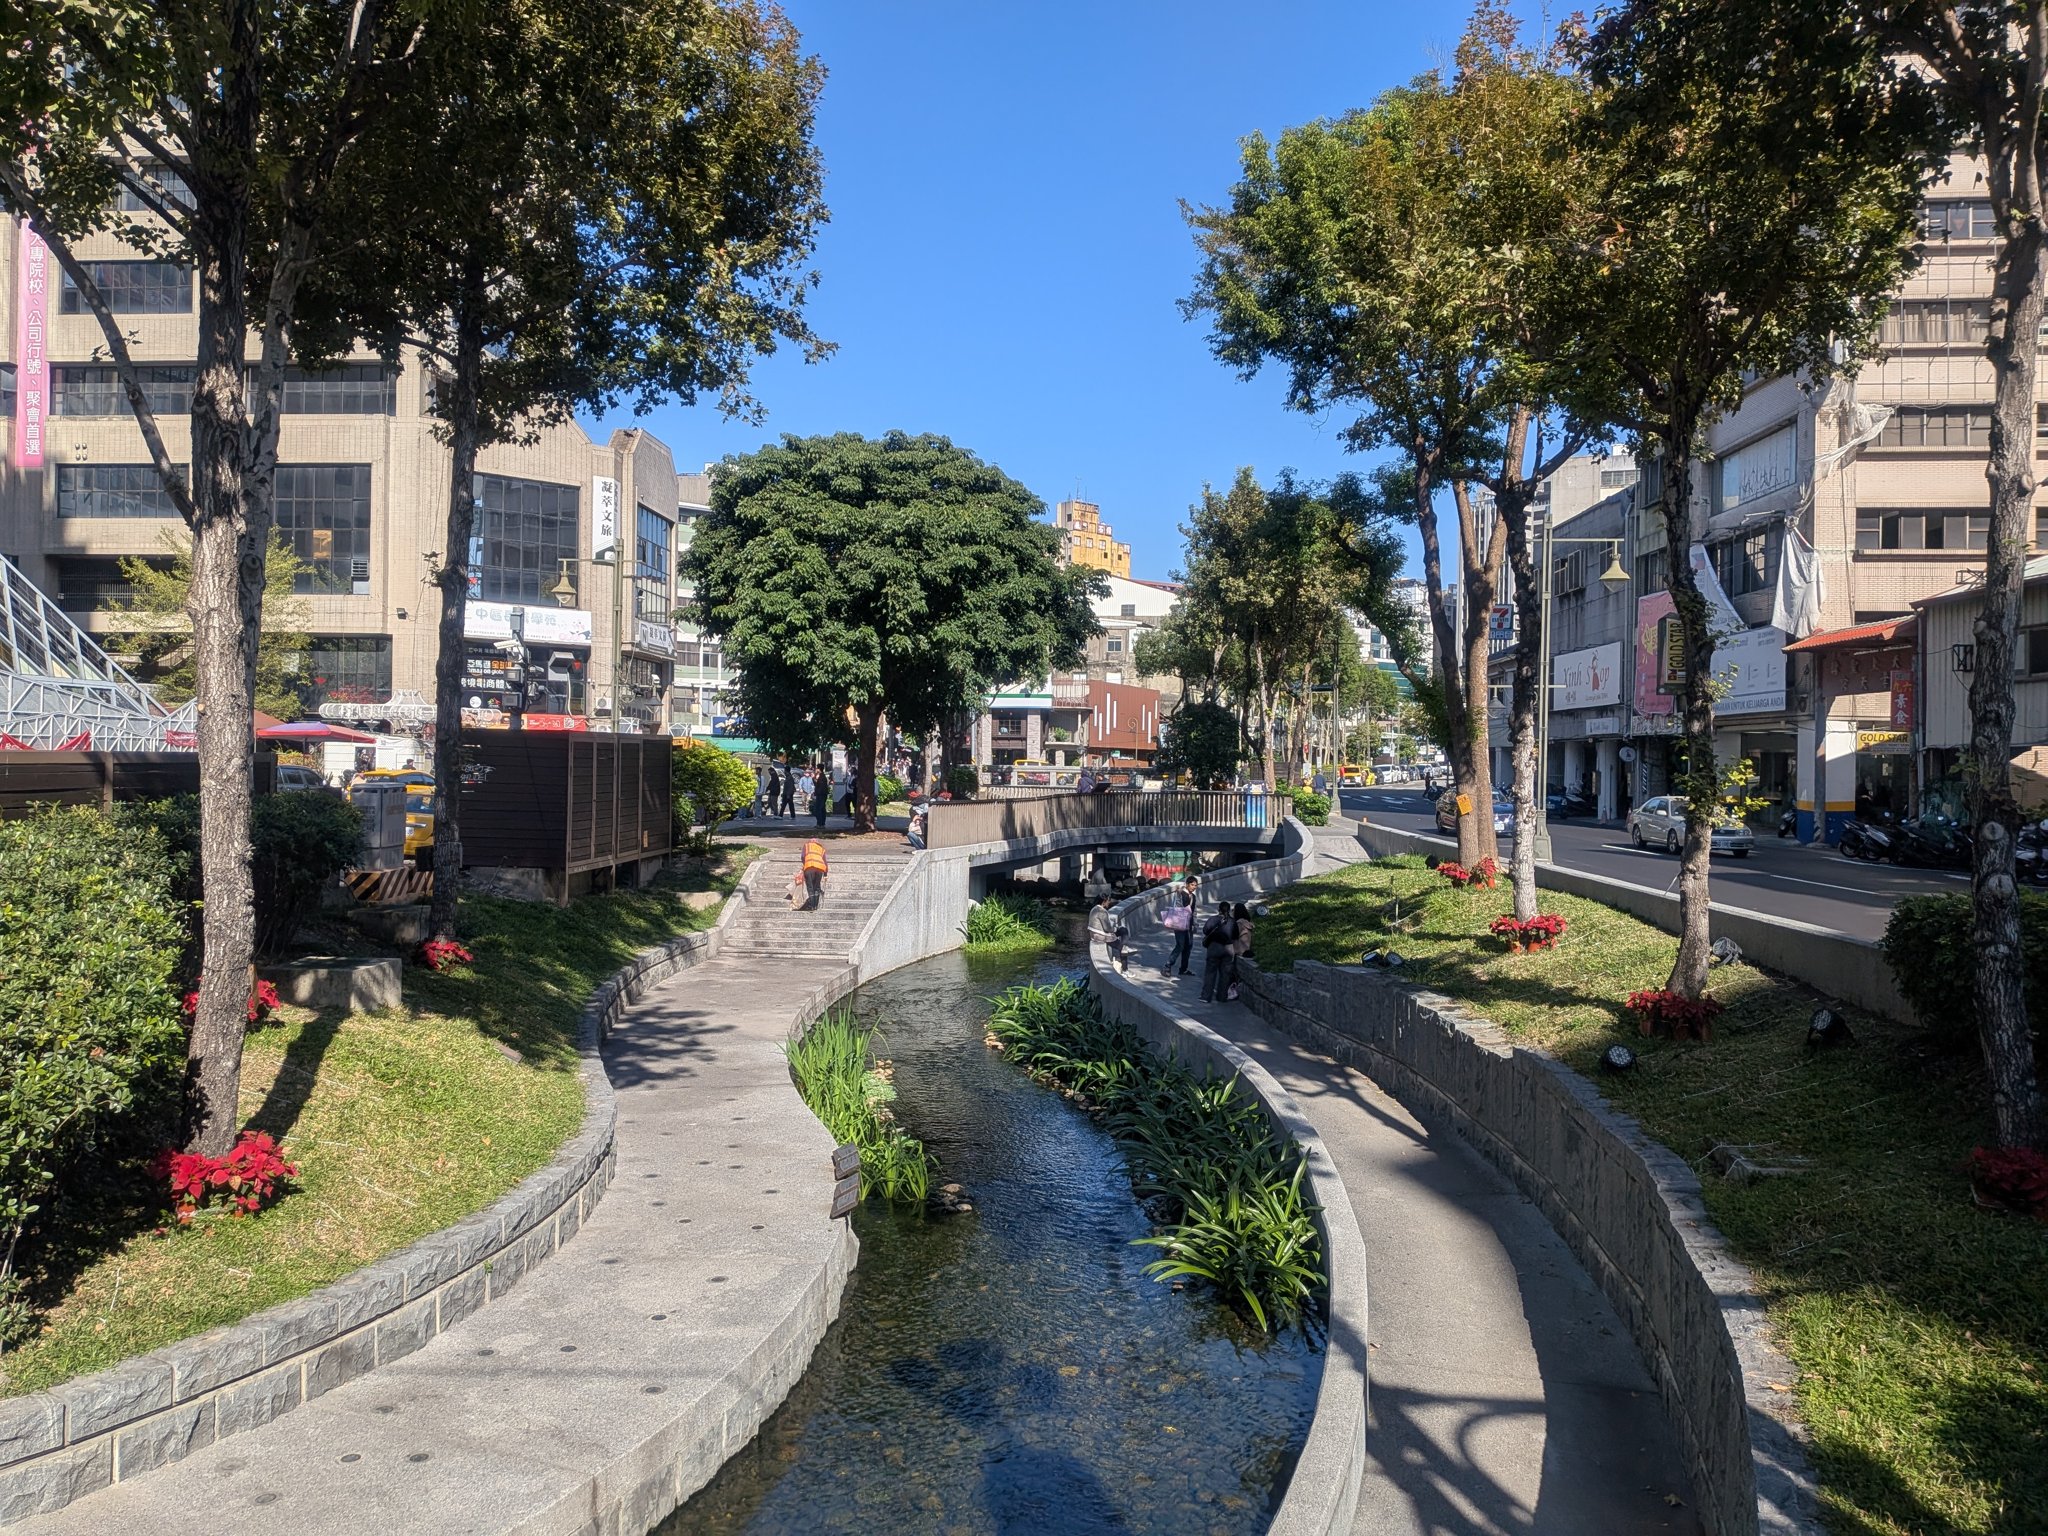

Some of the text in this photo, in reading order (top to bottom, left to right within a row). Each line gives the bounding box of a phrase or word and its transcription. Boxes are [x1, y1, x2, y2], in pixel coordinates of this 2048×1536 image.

[1669, 621, 1685, 669] GOLD STAR
[1860, 733, 1909, 744] GOLD STAR
